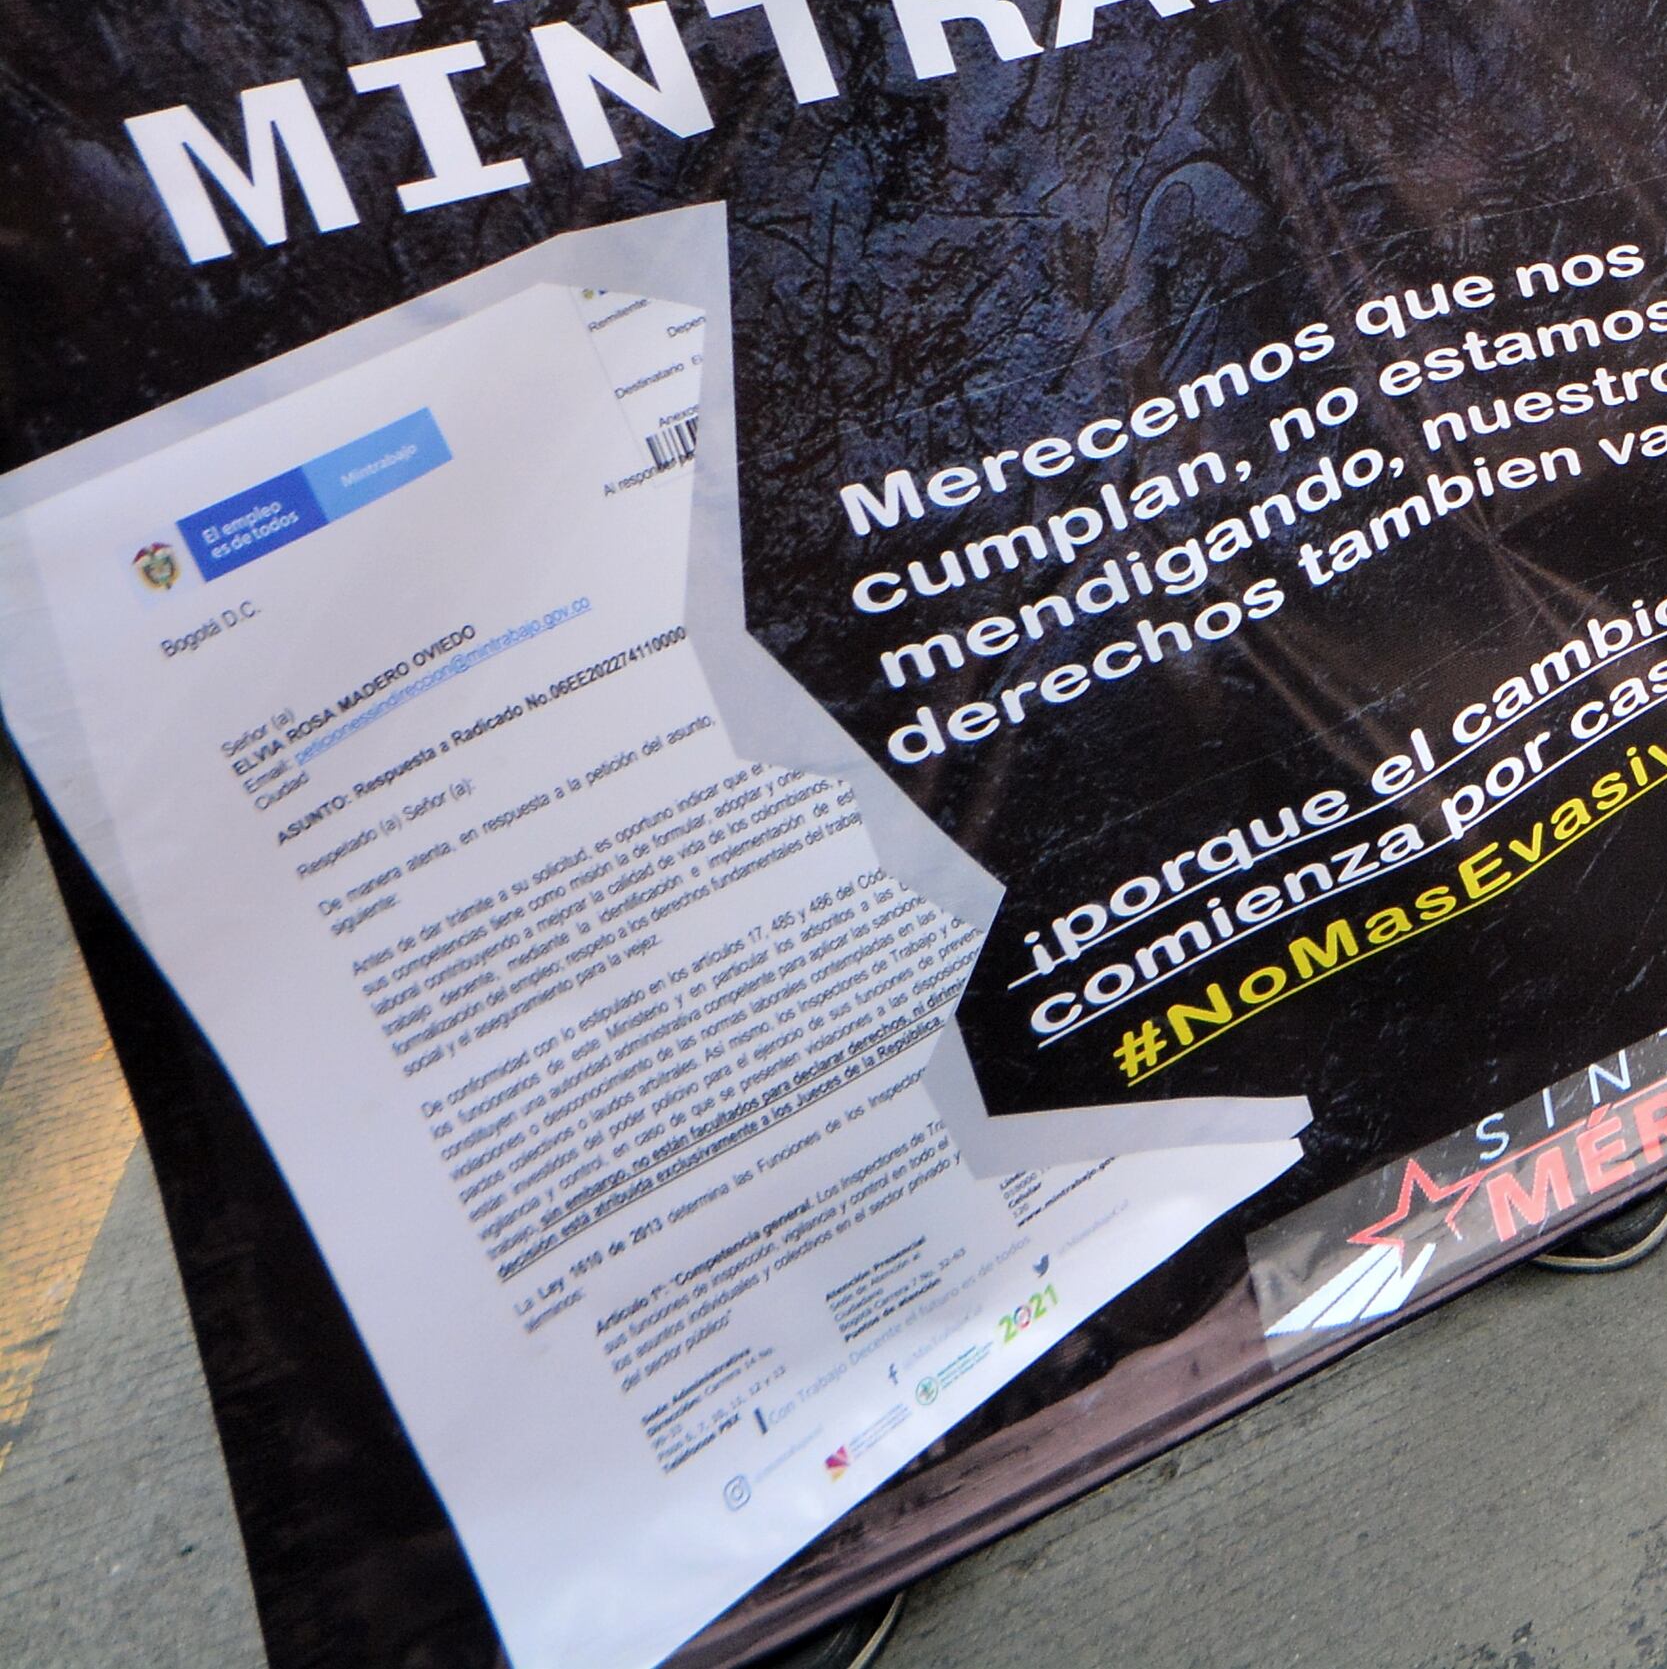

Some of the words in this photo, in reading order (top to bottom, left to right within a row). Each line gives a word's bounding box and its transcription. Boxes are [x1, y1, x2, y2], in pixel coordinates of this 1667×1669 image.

[340, 443, 420, 489] Mintrabajo
[840, 323, 1335, 535] Merecemos
[1356, 276, 1495, 338] que
[1516, 245, 1644, 297] nos
[202, 526, 221, 544] El
[220, 499, 283, 538] empleo
[210, 542, 233, 560] es
[229, 530, 253, 550] de
[251, 508, 300, 540] todos
[853, 452, 1251, 612] cumplan,
[1270, 387, 1358, 451] no
[881, 449, 1404, 687] mendigando,
[160, 617, 221, 659] Bogotá
[222, 598, 260, 627] D.C.
[888, 579, 1284, 762] derechos
[1298, 448, 1581, 584] tambien
[231, 736, 282, 774] ELVIA
[284, 705, 333, 742] ROSA
[335, 660, 410, 711] MADERO
[411, 622, 475, 667] OVIEDO
[275, 791, 350, 843] ASUNTO:
[352, 745, 437, 800] Respuesta
[439, 741, 449, 751] a
[450, 702, 523, 745] Radicado
[1372, 728, 1434, 794] el
[253, 770, 309, 810] Ciudad
[295, 826, 379, 880] Respetado
[403, 790, 446, 820] Señor
[317, 895, 342, 915] De
[346, 866, 402, 901] manera
[458, 828, 478, 843] en
[480, 790, 551, 835] respuesta
[553, 786, 564, 797] a
[566, 775, 581, 790] la
[583, 748, 639, 785] petición
[639, 736, 663, 755] del
[350, 945, 394, 975] Antes
[395, 934, 416, 952] de
[417, 920, 442, 940] dar
[445, 894, 494, 926] trámite
[497, 890, 508, 900] a
[511, 879, 529, 894] su
[593, 837, 611, 852] es
[613, 804, 675, 844] oportuno
[674, 781, 719, 811] indicar
[722, 770, 749, 791] que
[361, 976, 388, 996] sus
[390, 922, 488, 983] competencias
[488, 903, 525, 929] tiene
[527, 885, 566, 910] como
[567, 859, 613, 889] misión
[614, 851, 629, 866] la
[630, 840, 650, 858] de
[712, 784, 763, 820] adoptar
[775, 764, 804, 786] orie
[370, 982, 421, 1015] laboral
[422, 931, 521, 991] contribuyendo
[523, 927, 533, 938] a
[534, 897, 588, 934] mejorar
[589, 888, 604, 903] la
[605, 863, 655, 895] calidad
[655, 852, 675, 870] de
[677, 837, 705, 859] vida
[706, 827, 725, 844] de
[726, 816, 748, 834] los
[1031, 824, 1424, 1032] comienza
[1440, 732, 1550, 840] por
[866, 1065, 928, 1110] Inspector
[496, 1230, 557, 1276] decisión
[558, 1210, 591, 1237] está
[591, 1175, 653, 1217] atribuida
[654, 1117, 758, 1182] exclusivamente
[769, 1098, 791, 1118] los
[794, 1071, 840, 1104] Jueces
[994, 1283, 1061, 1341] 2021
